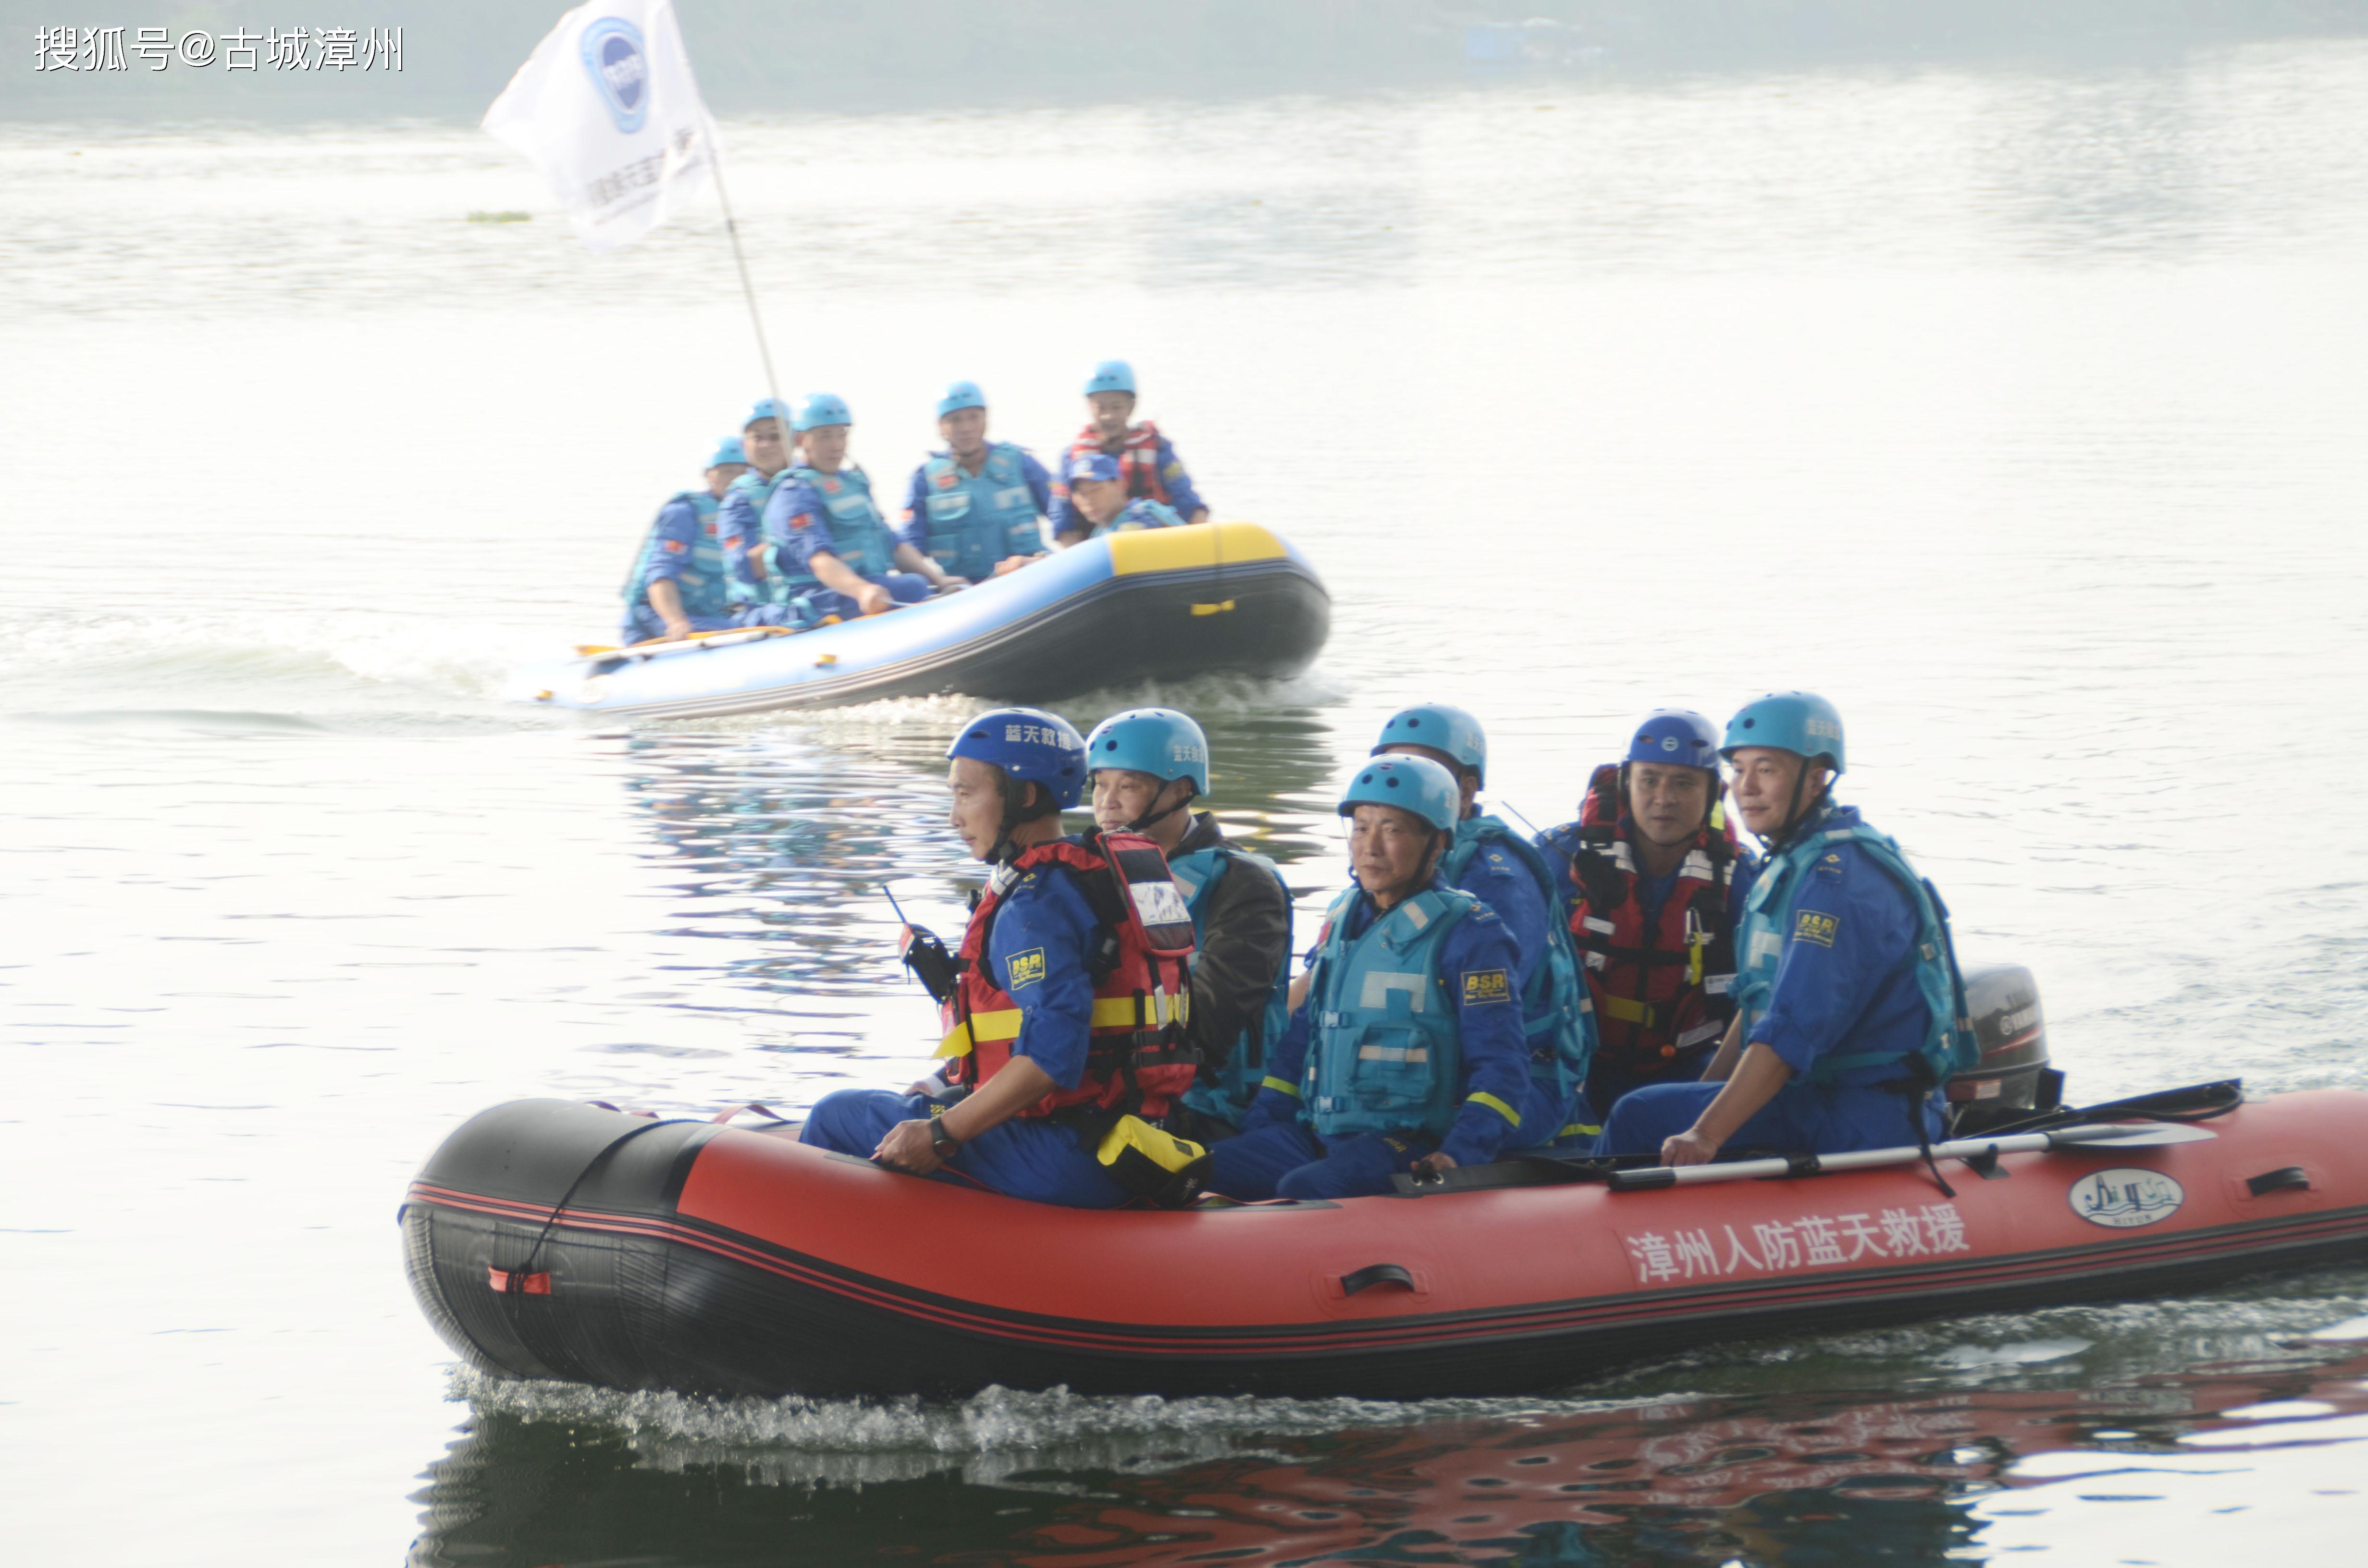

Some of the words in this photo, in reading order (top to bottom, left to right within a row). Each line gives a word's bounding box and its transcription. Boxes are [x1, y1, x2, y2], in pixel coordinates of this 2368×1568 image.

[1005, 724, 1072, 751] 蓝天救援
[1012, 954, 1042, 975] BSR
[1467, 974, 1505, 990] BSR
[1628, 1203, 1970, 1284] 漳州人防蓝天救援
